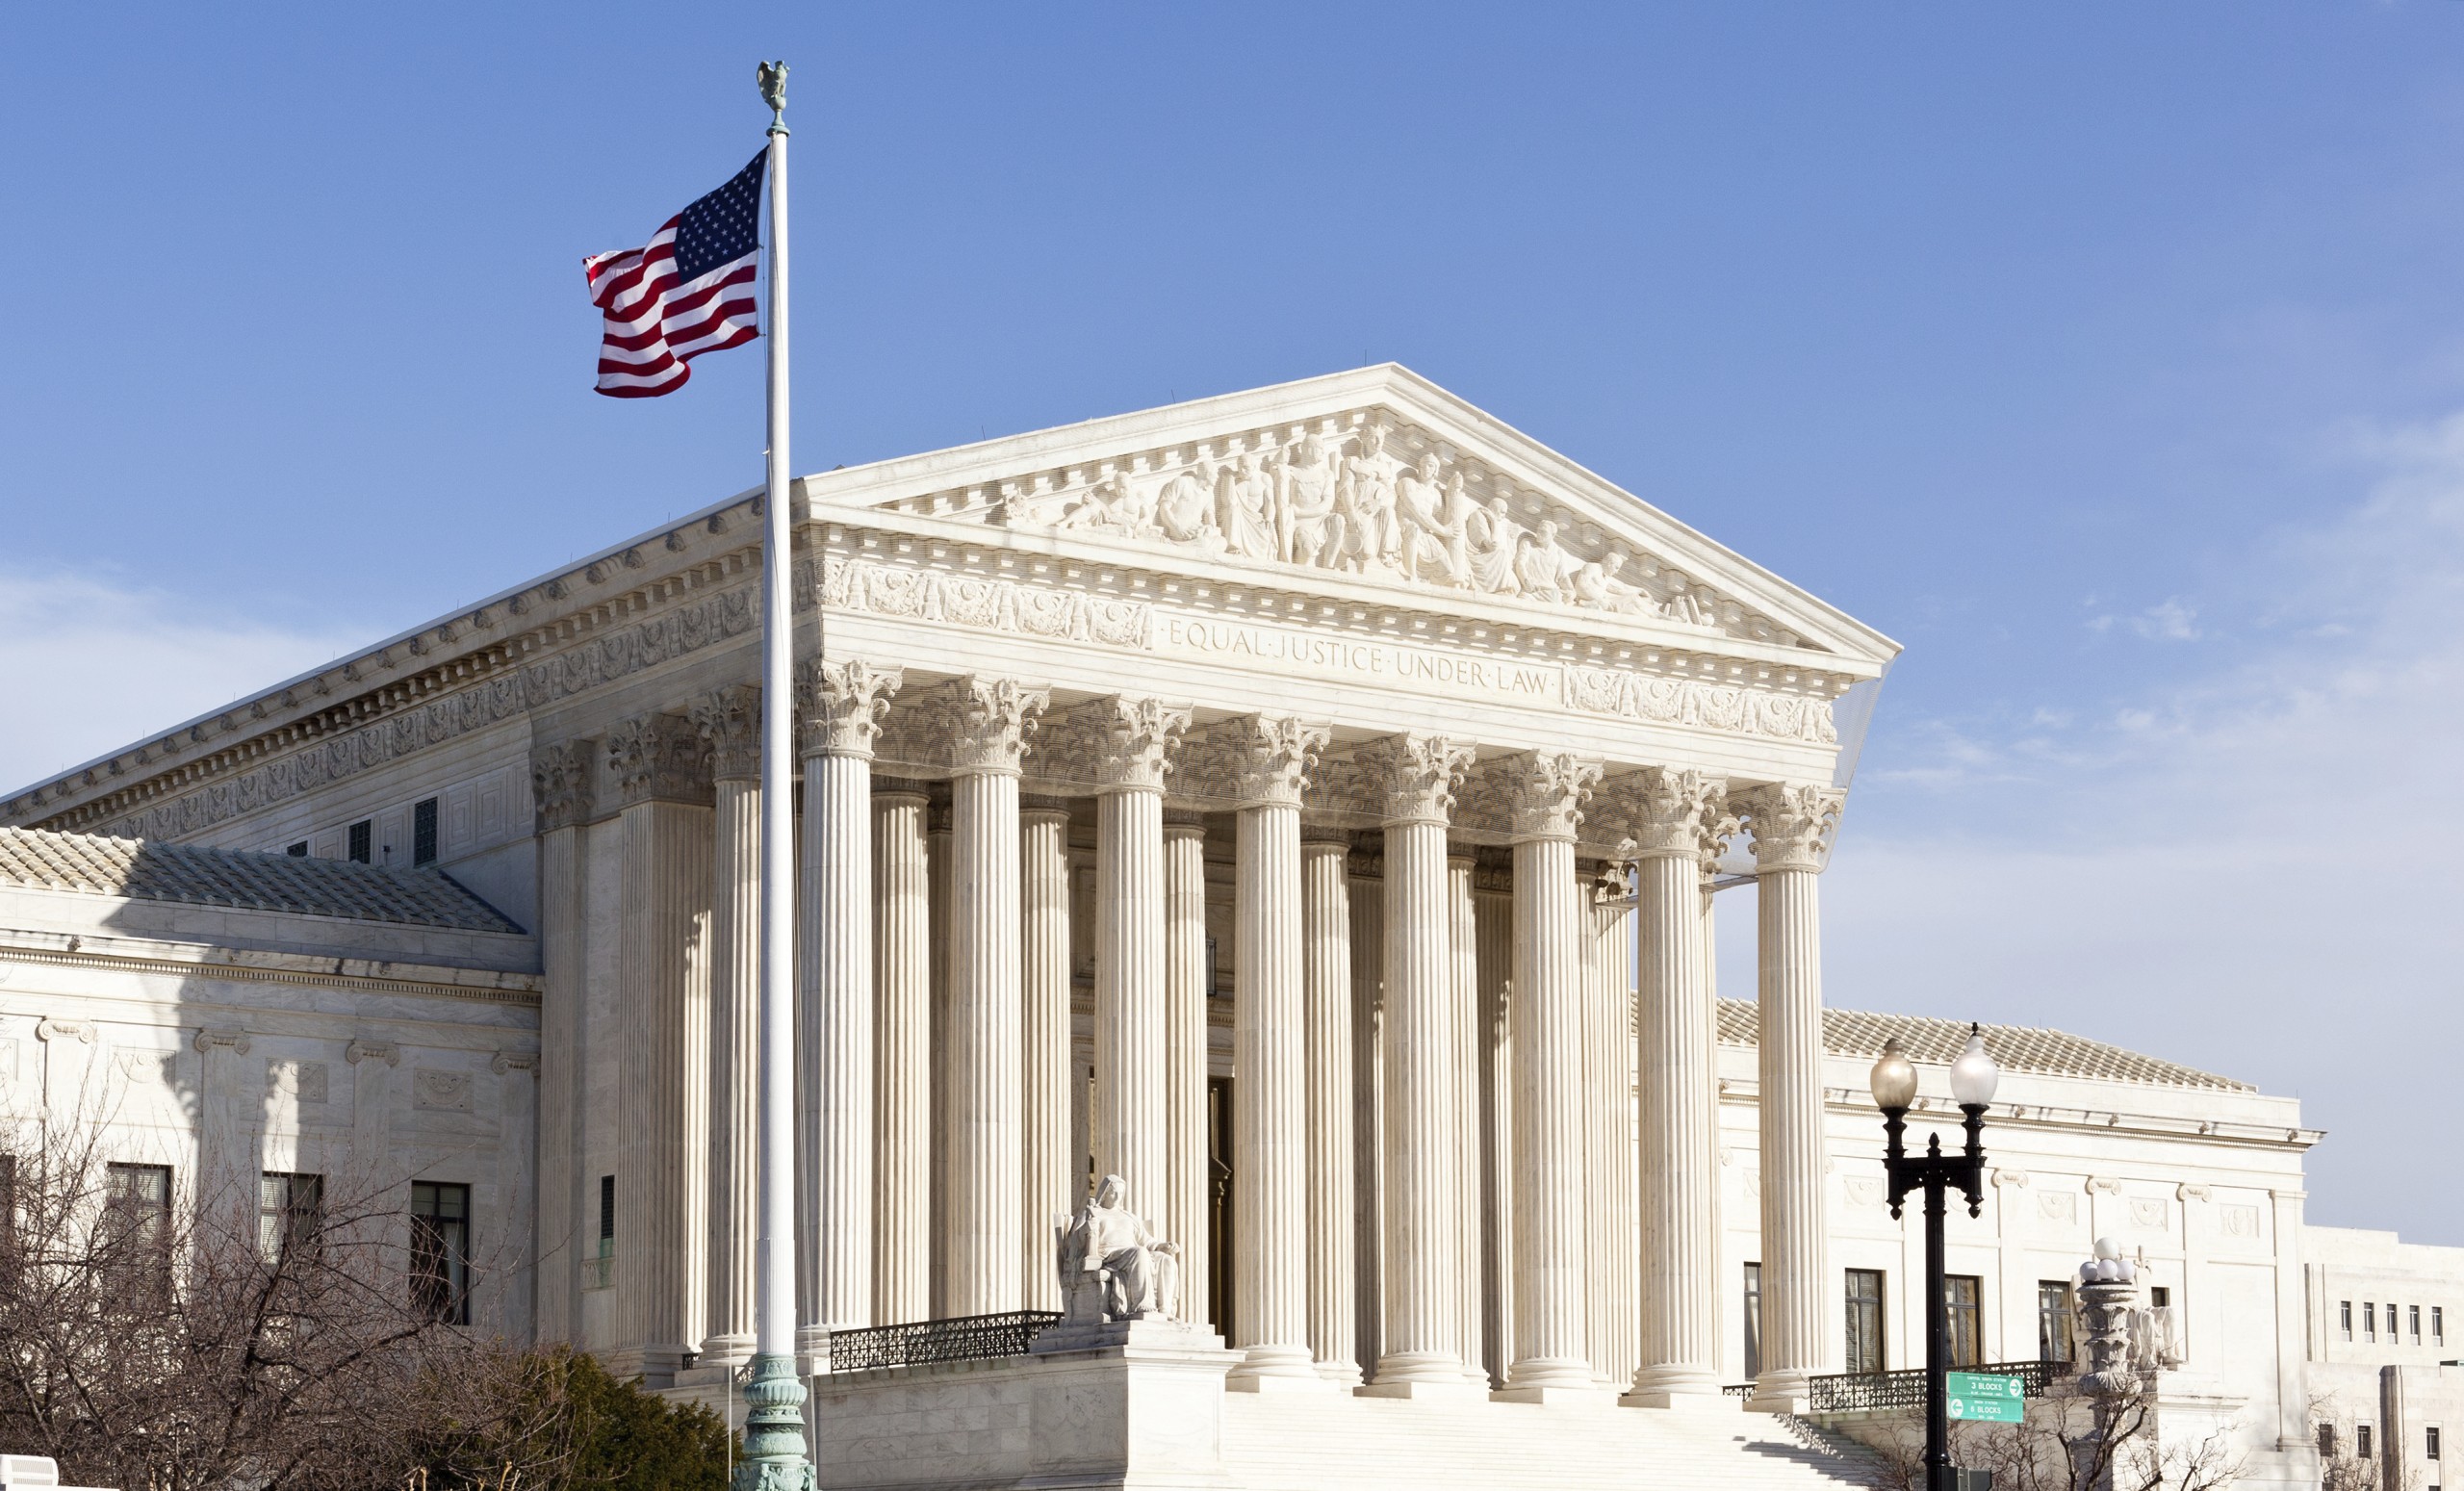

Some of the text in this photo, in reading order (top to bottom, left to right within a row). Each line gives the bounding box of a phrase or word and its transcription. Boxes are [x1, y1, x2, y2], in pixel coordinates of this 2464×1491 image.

[1170, 620, 1548, 694] EQUAL JUSTICE UNDER LAW
[1978, 1382, 2002, 1391] BLOCKS
